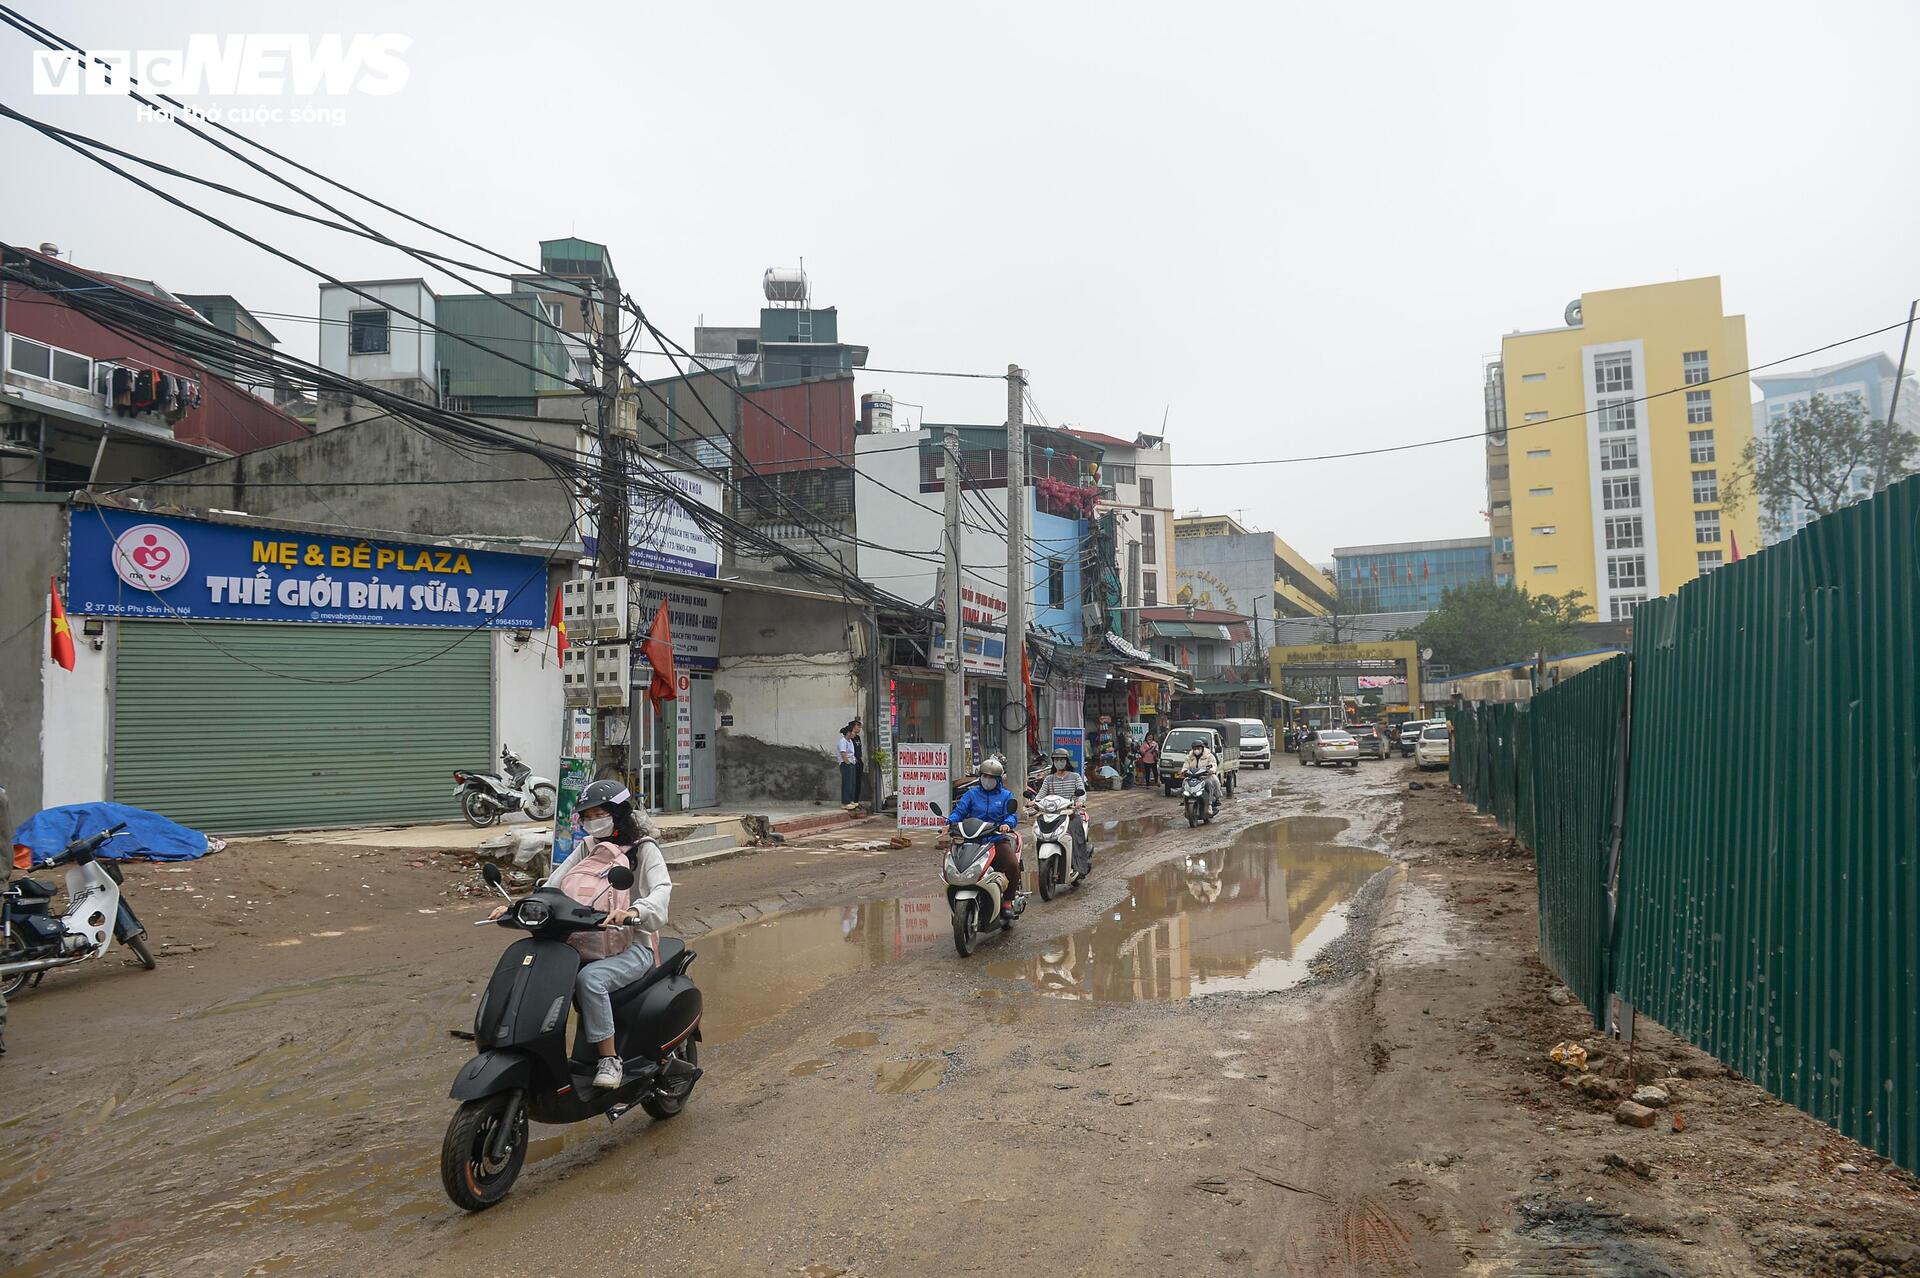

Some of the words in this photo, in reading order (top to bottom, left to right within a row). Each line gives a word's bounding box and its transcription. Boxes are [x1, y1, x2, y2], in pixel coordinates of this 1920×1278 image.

[252, 540, 298, 570] MẸ
[304, 544, 325, 566] &
[331, 543, 371, 569] BÉ
[377, 549, 472, 574] PLAZA
[206, 565, 272, 605] THẾ
[277, 573, 342, 607] GIỚI
[348, 576, 404, 610] BỈM
[410, 580, 461, 613] SỮA
[466, 589, 509, 613] 247
[681, 594, 692, 608] PHỤ
[692, 596, 708, 609] KHOA
[127, 605, 143, 614] Phụ
[177, 606, 191, 615] Nội
[320, 612, 383, 622] mevabeplaza.com
[899, 748, 918, 765] PHÒNG
[918, 748, 934, 765] KHÁM
[935, 747, 943, 766] SỐ
[943, 751, 947, 766] 9
[903, 770, 919, 781] KHÁM
[920, 771, 931, 783] PHỤ
[932, 771, 947, 781] KHOA
[902, 785, 915, 796] SIÊU
[916, 786, 925, 796] ÂM
[902, 800, 912, 813] ĐẶT
[914, 800, 929, 811] VÒNG
